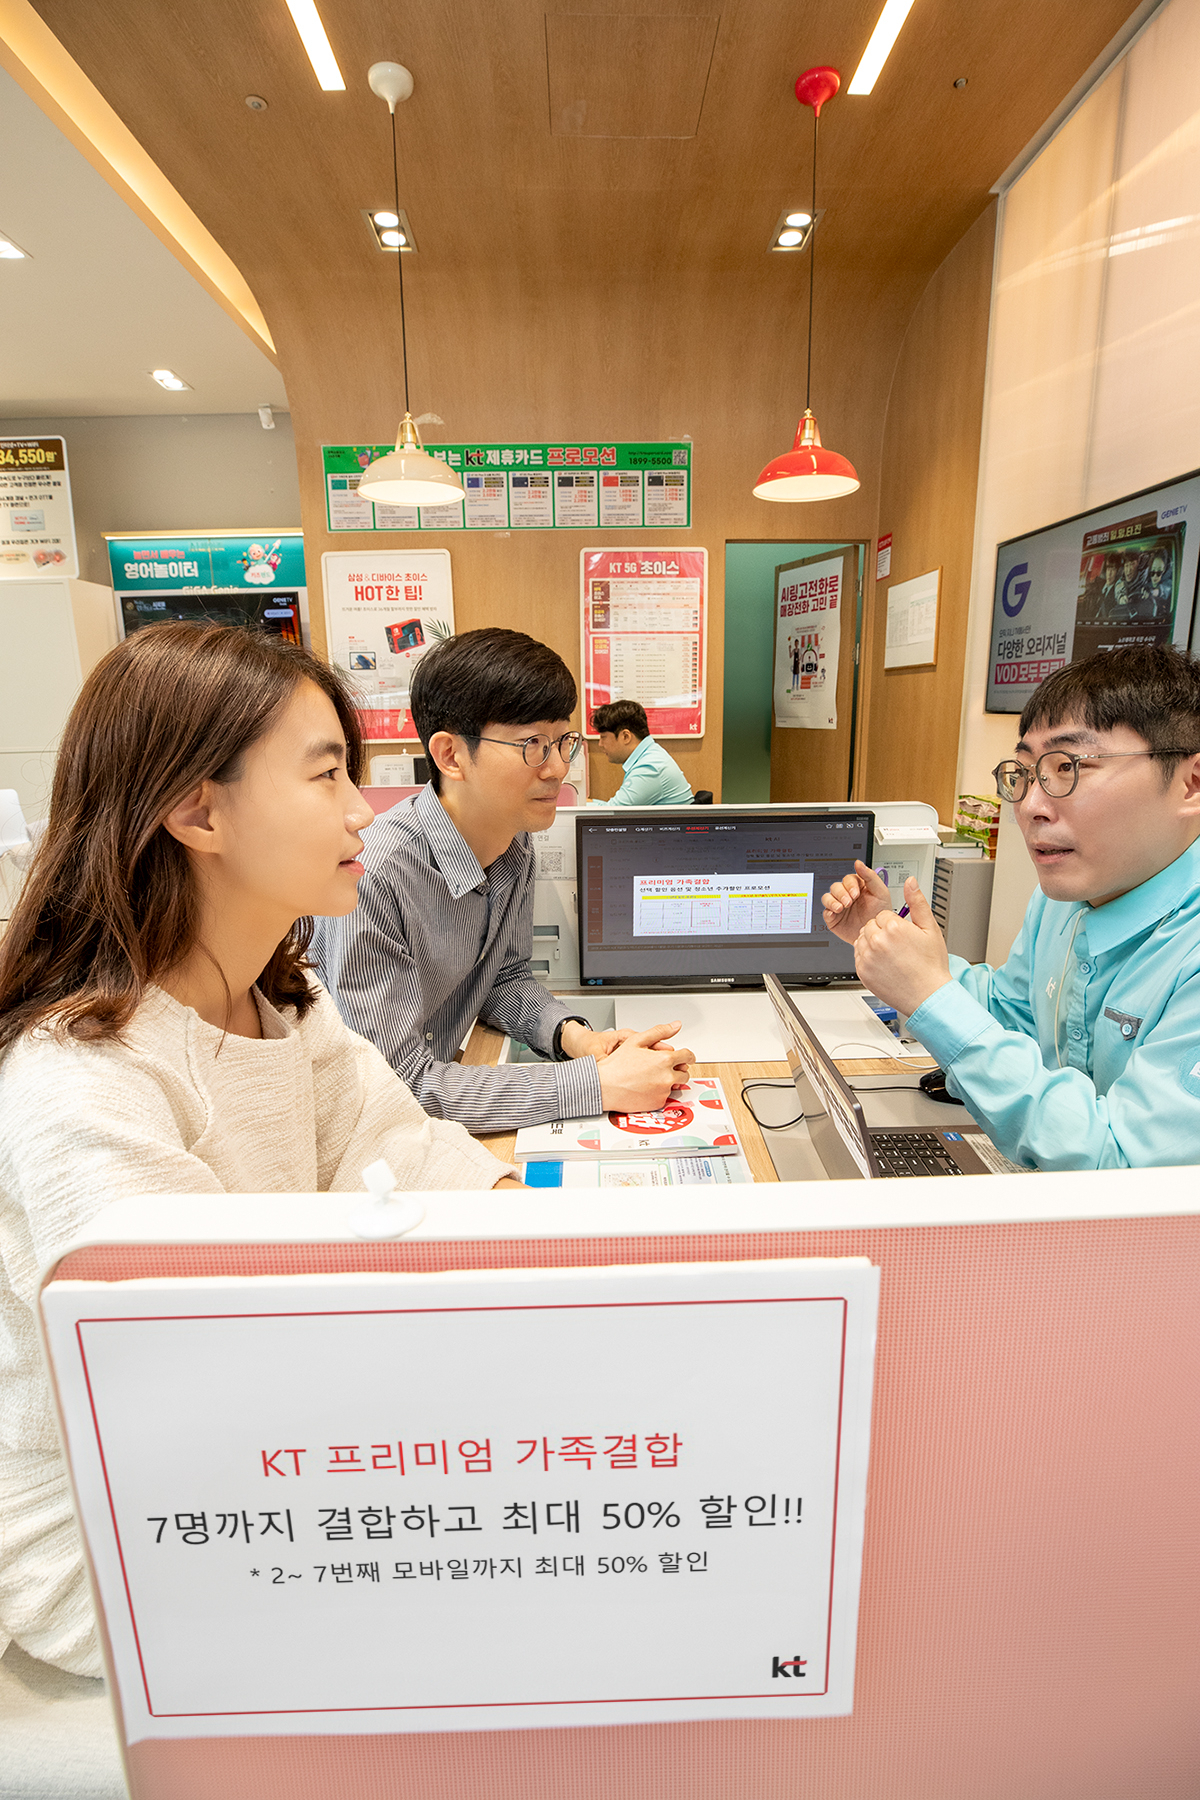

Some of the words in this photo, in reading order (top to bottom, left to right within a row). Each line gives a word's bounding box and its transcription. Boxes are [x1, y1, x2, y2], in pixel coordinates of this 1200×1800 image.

[465, 449, 484, 466] kt
[486, 449, 544, 465] 제휴카드
[547, 447, 617, 466] 프로모션
[629, 457, 672, 465] 1899-5500
[124, 561, 199, 579] 영어놀이터
[347, 573, 363, 582] 삼성
[371, 573, 402, 582] 디바이스
[405, 573, 428, 582] 초이스
[609, 563, 622, 573] KT
[624, 562, 637, 573] 5G
[640, 561, 679, 575] 초이스
[404, 585, 423, 601] 팁!
[781, 575, 839, 603] AI링고전화로
[780, 600, 810, 617] 매장전화
[811, 598, 827, 612] 고민
[830, 595, 838, 608] 끝
[998, 638, 1024, 659] 다양한
[1026, 632, 1066, 656] 오리지널
[996, 664, 1018, 682] VOD
[1019, 663, 1038, 682] 모두
[689, 723, 698, 731] kt
[262, 1449, 306, 1477] KT
[327, 1439, 491, 1476] 프리미엄
[517, 1433, 682, 1471] 가족결합
[147, 1509, 294, 1544] 7명까지
[318, 1505, 482, 1540] 결합하고
[503, 1500, 579, 1534] 최대
[603, 1502, 680, 1529] 50%
[700, 1494, 802, 1528] 할인!!
[272, 1567, 302, 1584] 2~
[314, 1562, 379, 1583] 7번째
[393, 1557, 521, 1581] 모바일까지
[536, 1555, 584, 1577] 최대
[598, 1556, 647, 1573] 50%
[659, 1551, 707, 1573] 할인
[771, 1655, 808, 1679] kt
